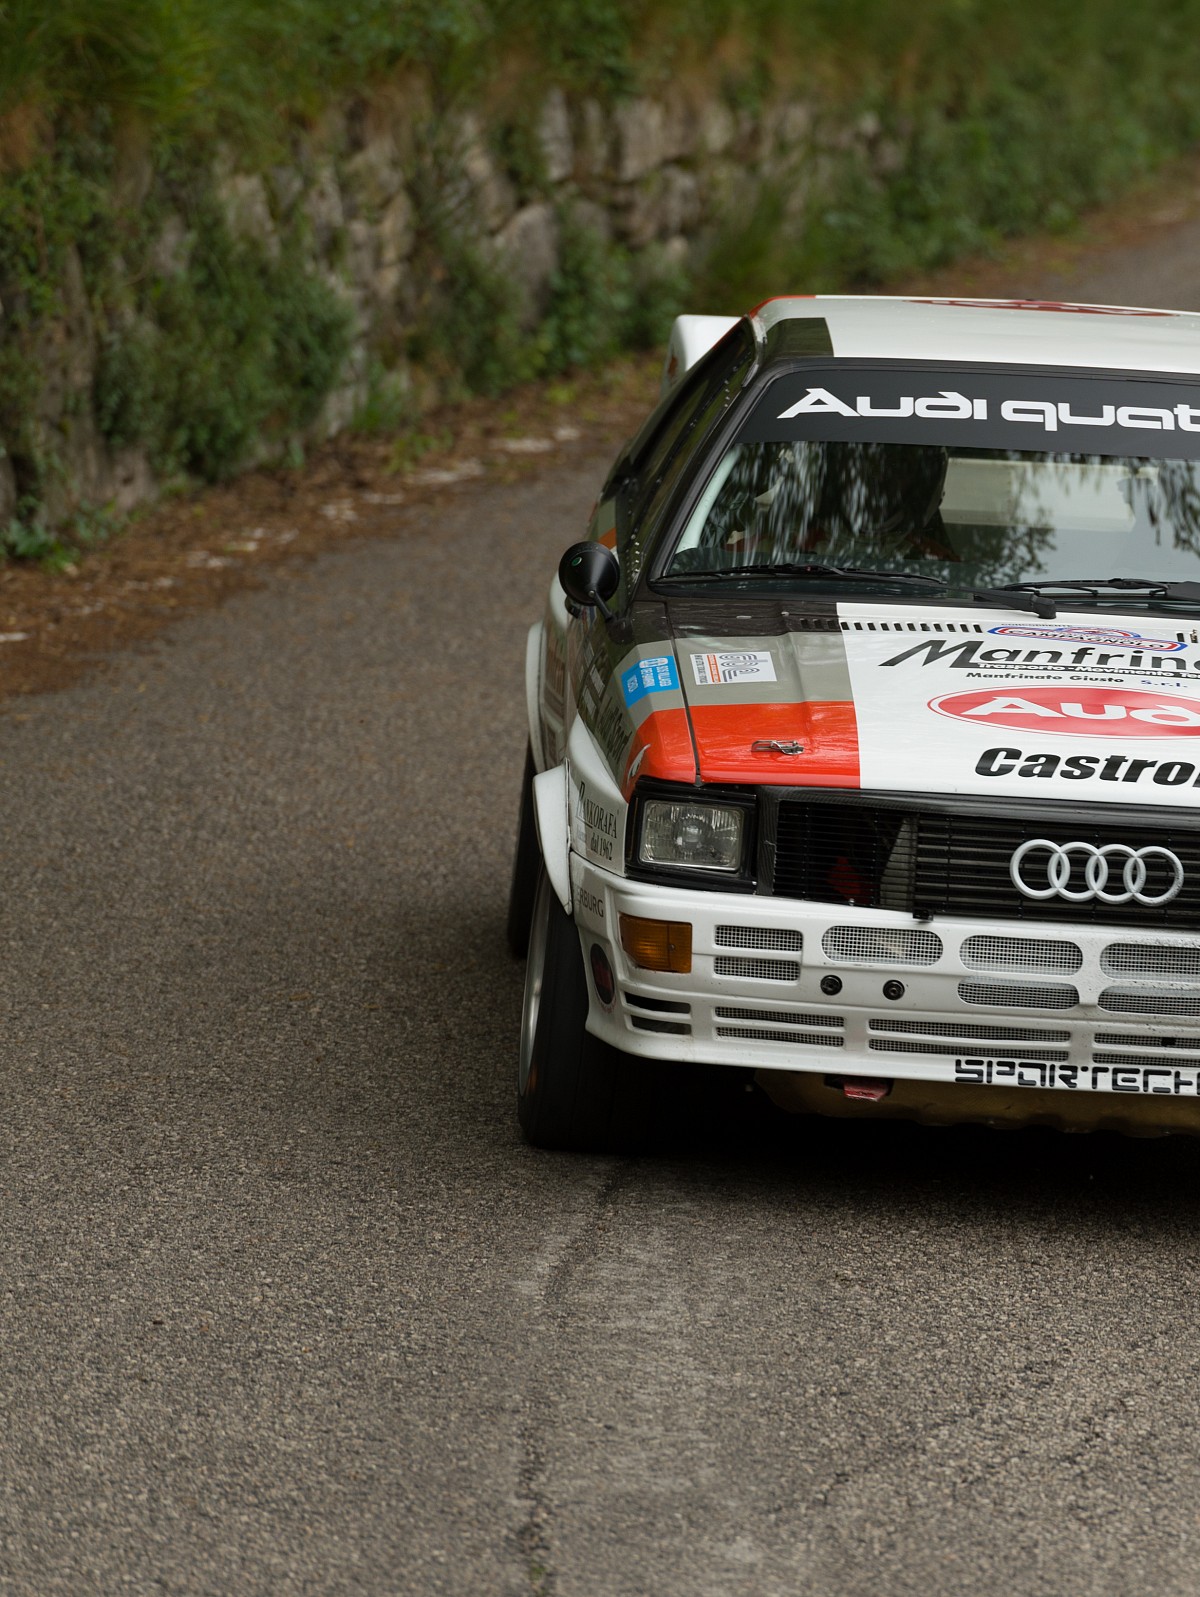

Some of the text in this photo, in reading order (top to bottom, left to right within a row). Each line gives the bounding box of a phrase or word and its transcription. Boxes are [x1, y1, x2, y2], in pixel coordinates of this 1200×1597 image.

[776, 387, 988, 420] Audi
[1007, 629, 1166, 649] CAMPAGNOLO
[965, 671, 1063, 681] Manfrinato
[1069, 674, 1125, 683] Giusto
[977, 662, 1066, 673] Trasporto
[599, 839, 613, 861] 1962
